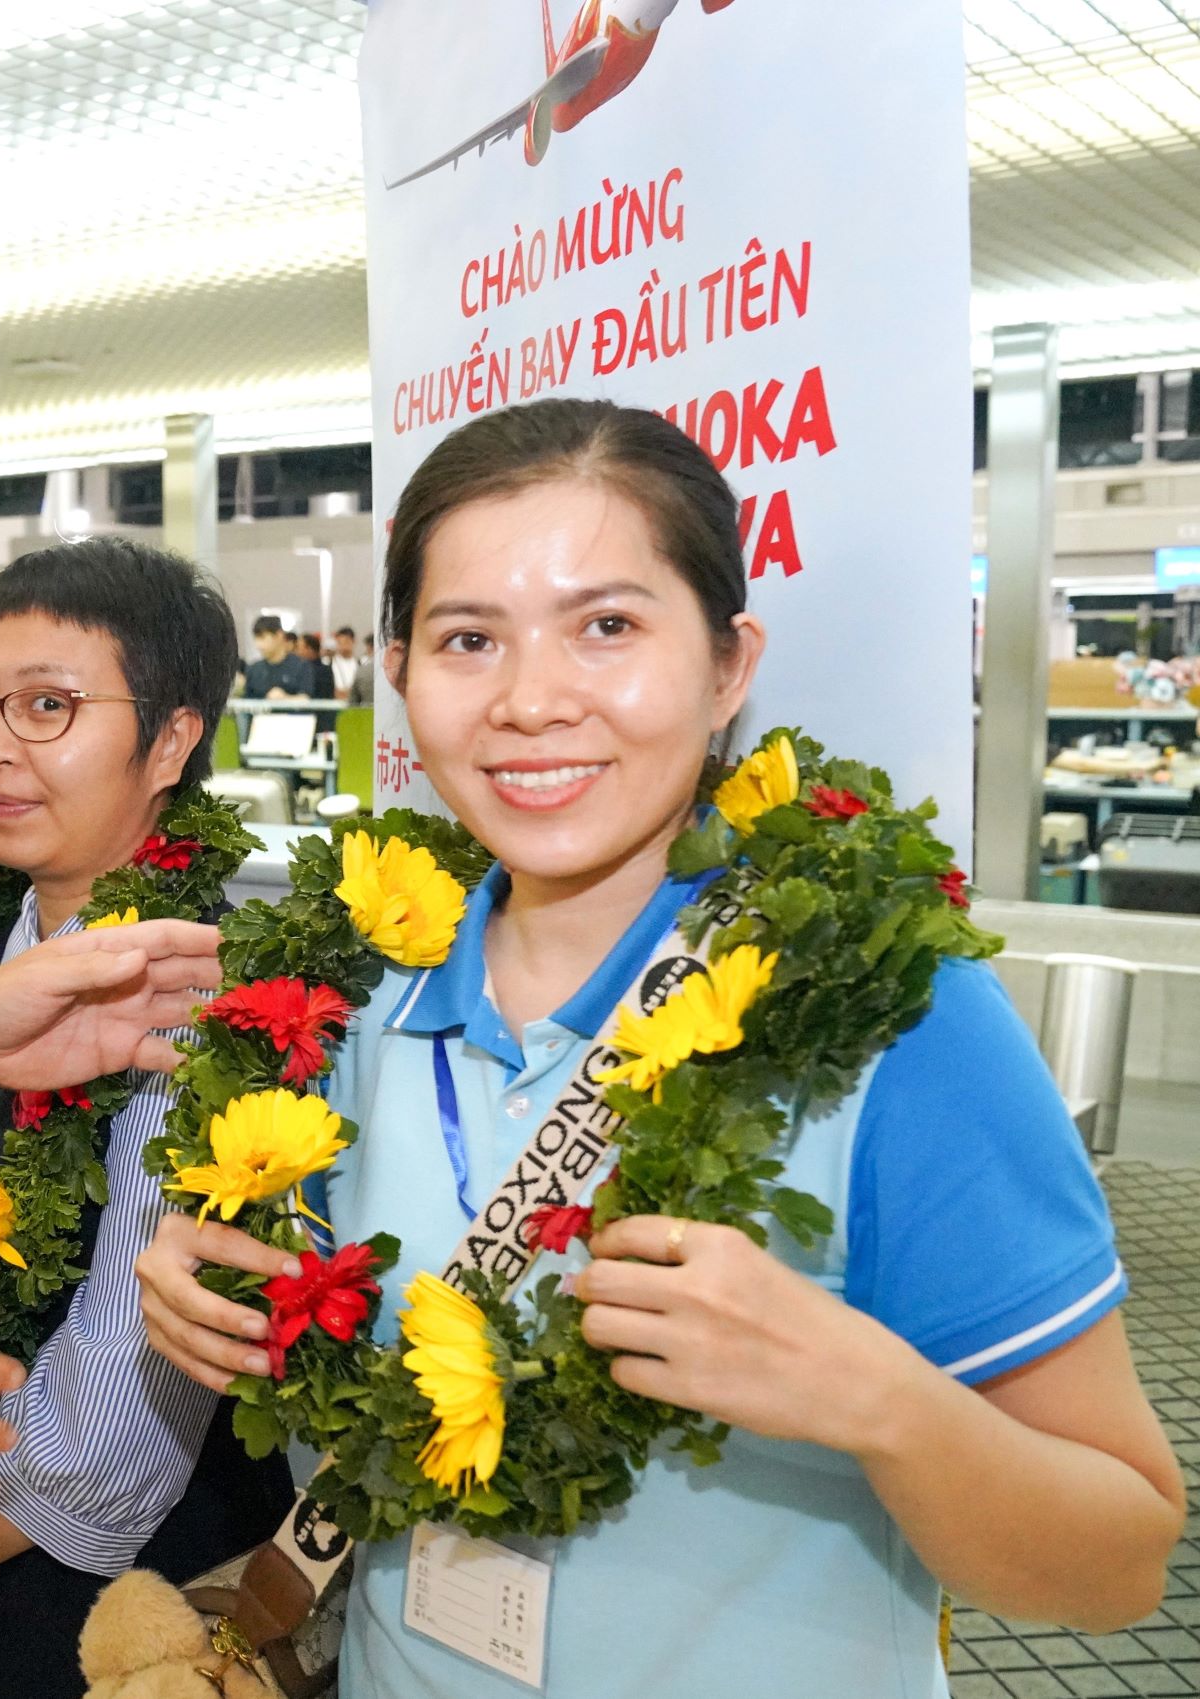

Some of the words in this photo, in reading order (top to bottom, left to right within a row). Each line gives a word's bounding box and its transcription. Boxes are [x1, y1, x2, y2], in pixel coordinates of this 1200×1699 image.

[461, 224, 546, 318] CHÀO
[554, 167, 684, 281] MỪNG
[393, 327, 511, 435] CHUYẾN
[520, 318, 581, 400] BAY
[592, 268, 687, 376] ĐẦU
[699, 237, 811, 344] TIÊN
